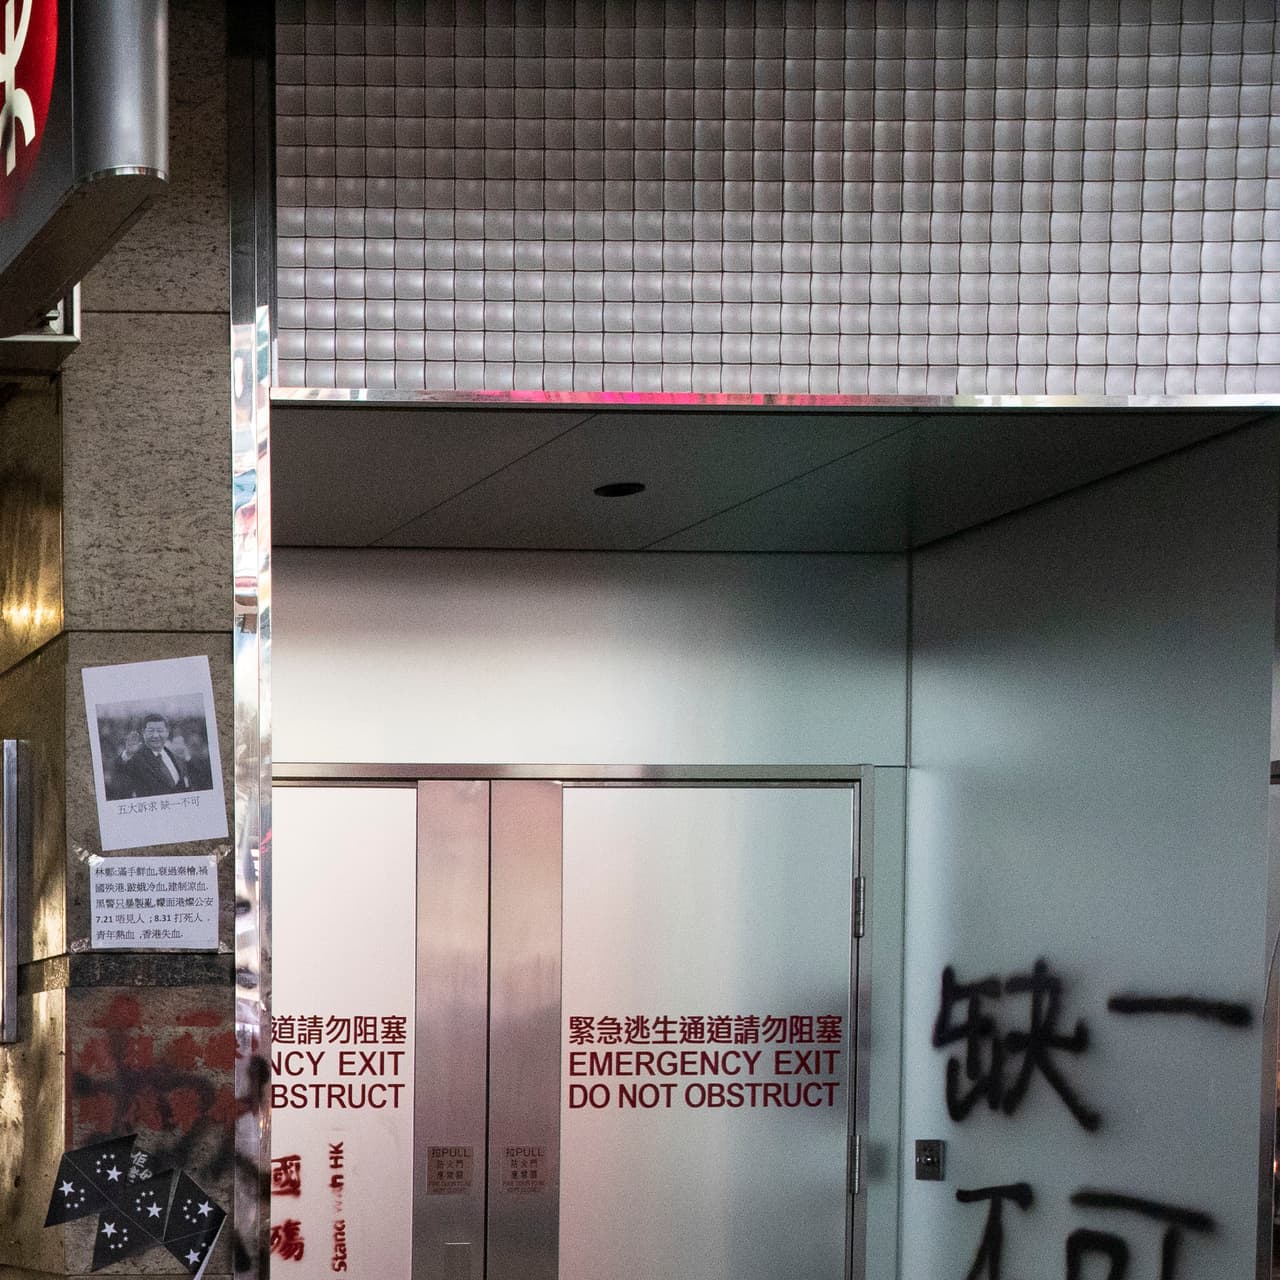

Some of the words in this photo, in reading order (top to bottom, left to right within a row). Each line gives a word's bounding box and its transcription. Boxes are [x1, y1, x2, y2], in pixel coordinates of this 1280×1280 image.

[96, 915, 113, 923] 7.21
[271, 1014, 408, 1047] 道請勿阻塞
[568, 1014, 843, 1047] 緊急逃生通道請勿阻塞
[930, 958, 1254, 1134] 缺一
[338, 1050, 406, 1077] EXIT
[568, 1050, 762, 1078] EMERGENCY
[774, 1050, 841, 1075] EXIT
[568, 1083, 612, 1110] DO
[618, 1083, 676, 1109] NOT
[684, 1081, 841, 1108] OBSTRUCT
[329, 1141, 345, 1169] HK
